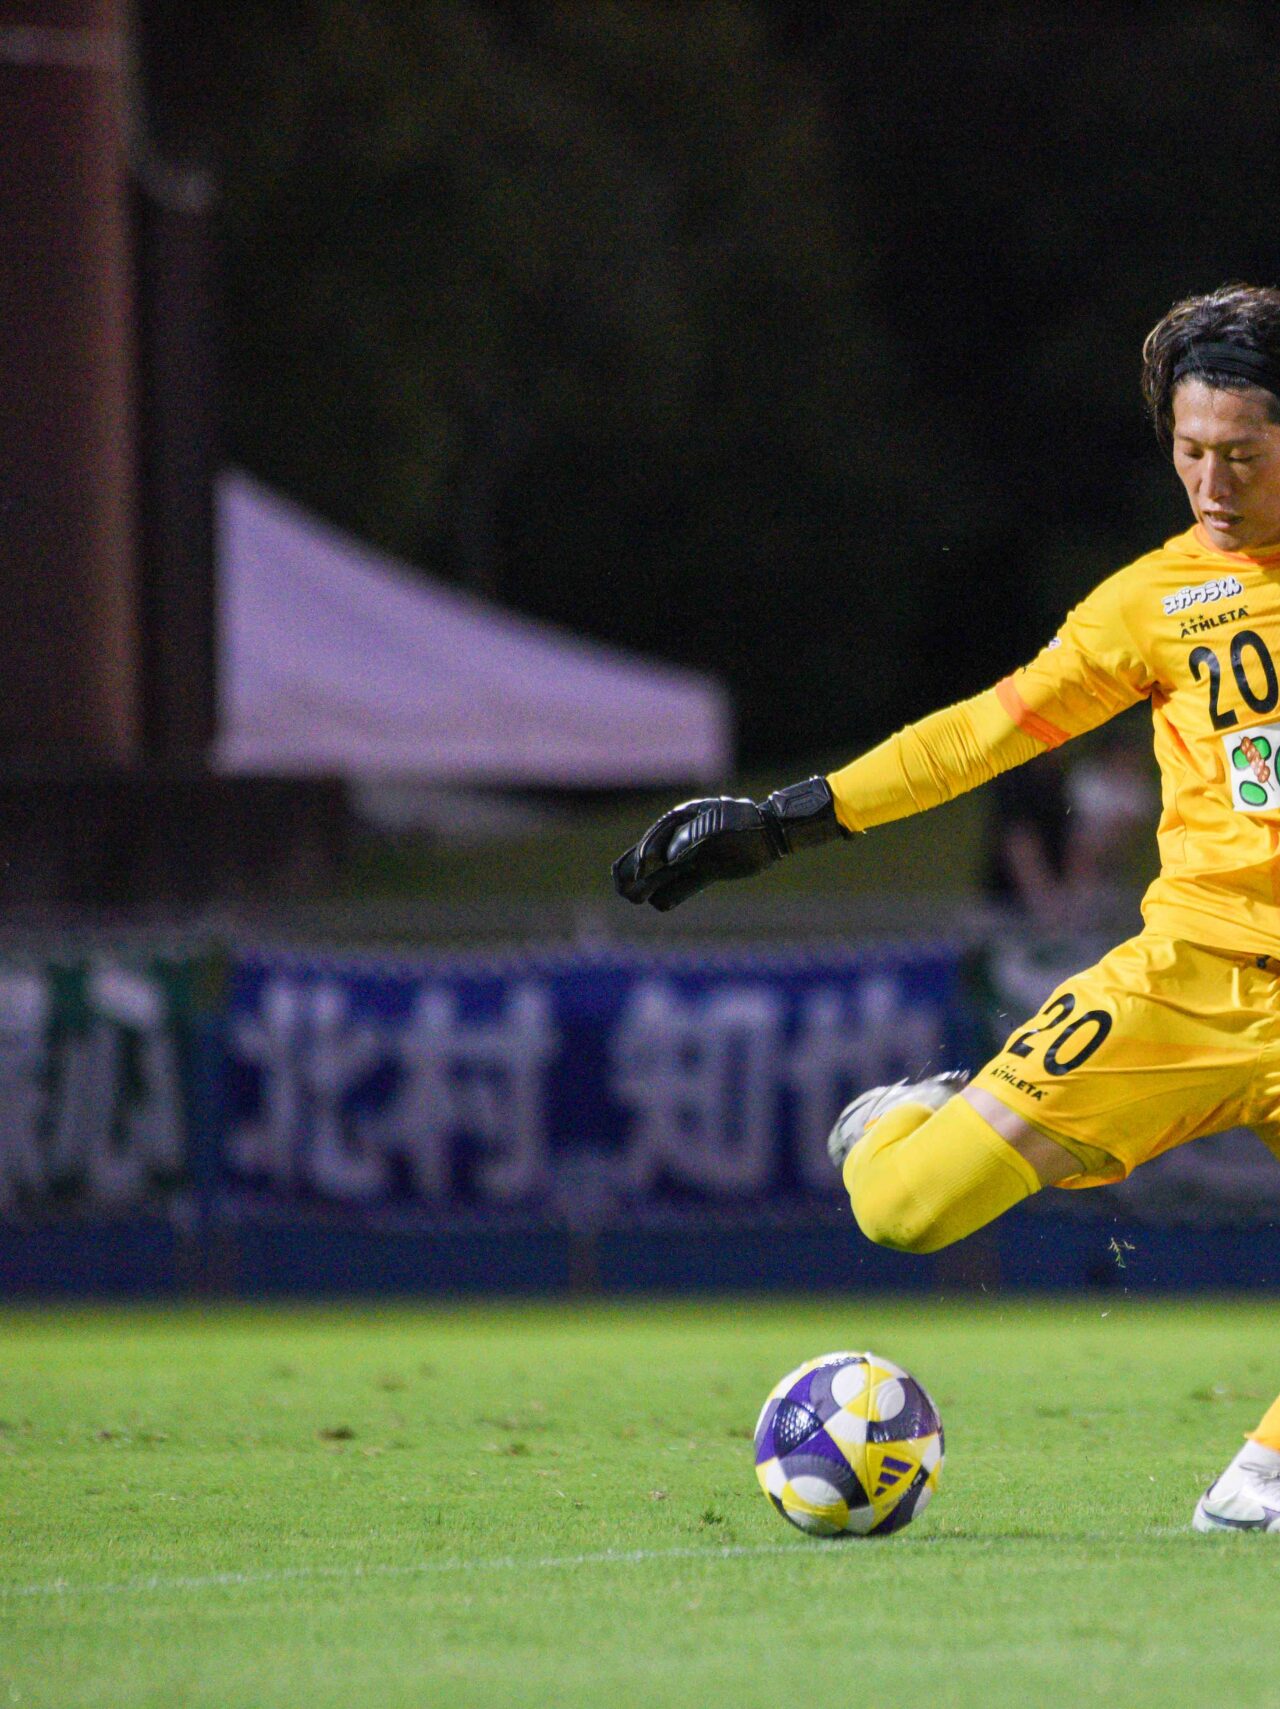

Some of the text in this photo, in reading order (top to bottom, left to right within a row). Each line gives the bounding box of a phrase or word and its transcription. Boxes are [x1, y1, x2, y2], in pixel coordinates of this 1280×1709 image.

[1162, 576, 1243, 615] スガワラくん
[1180, 607, 1249, 639] ATHLETA
[1189, 630, 1279, 731] 20
[1007, 993, 1112, 1076] 20
[990, 1068, 1043, 1101] ATHLETA
